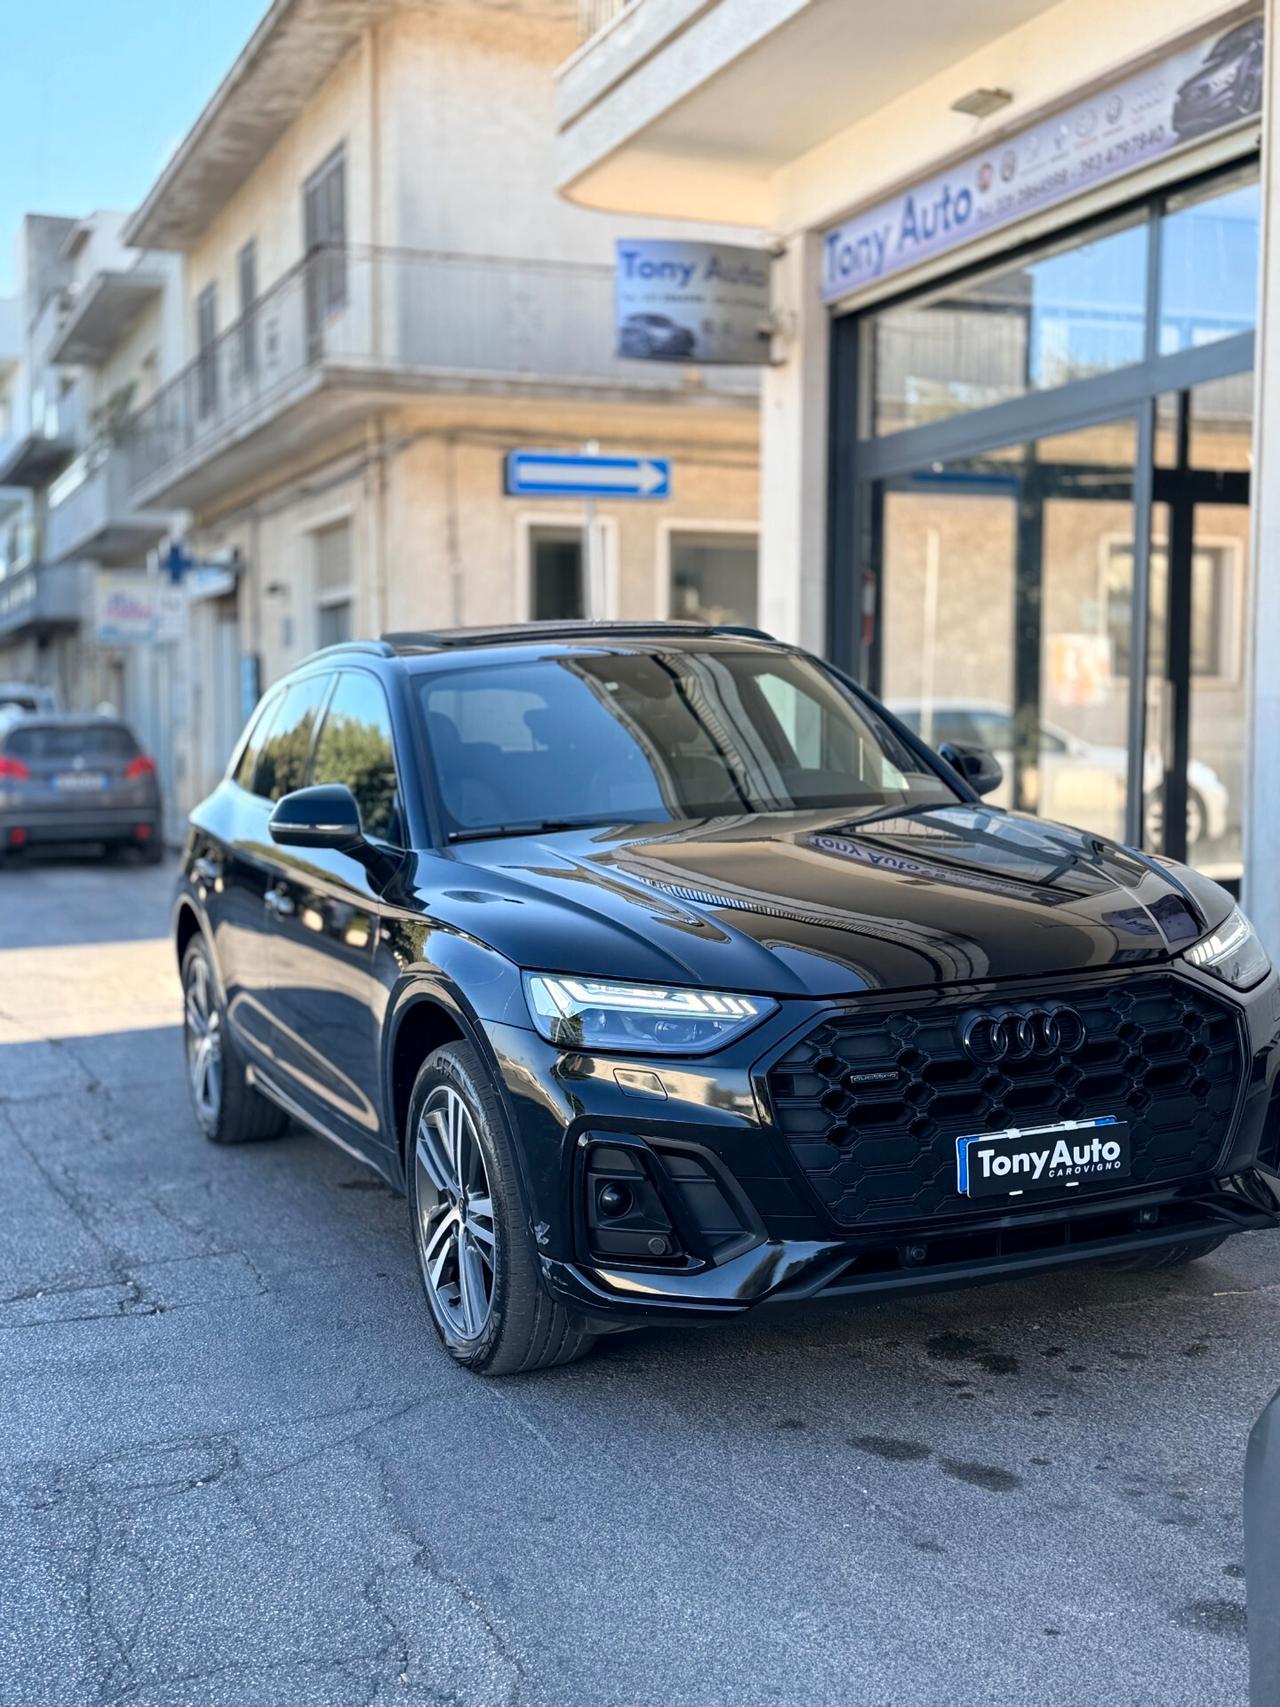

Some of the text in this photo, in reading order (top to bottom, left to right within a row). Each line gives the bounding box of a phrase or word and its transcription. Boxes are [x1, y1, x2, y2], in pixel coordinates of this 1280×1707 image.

[825, 223, 892, 283] Tony
[897, 182, 972, 252] Auto
[620, 251, 695, 288] Tony
[977, 1139, 1121, 1180] TonyAuto
[1048, 1161, 1122, 1178] CAROVIGNO
